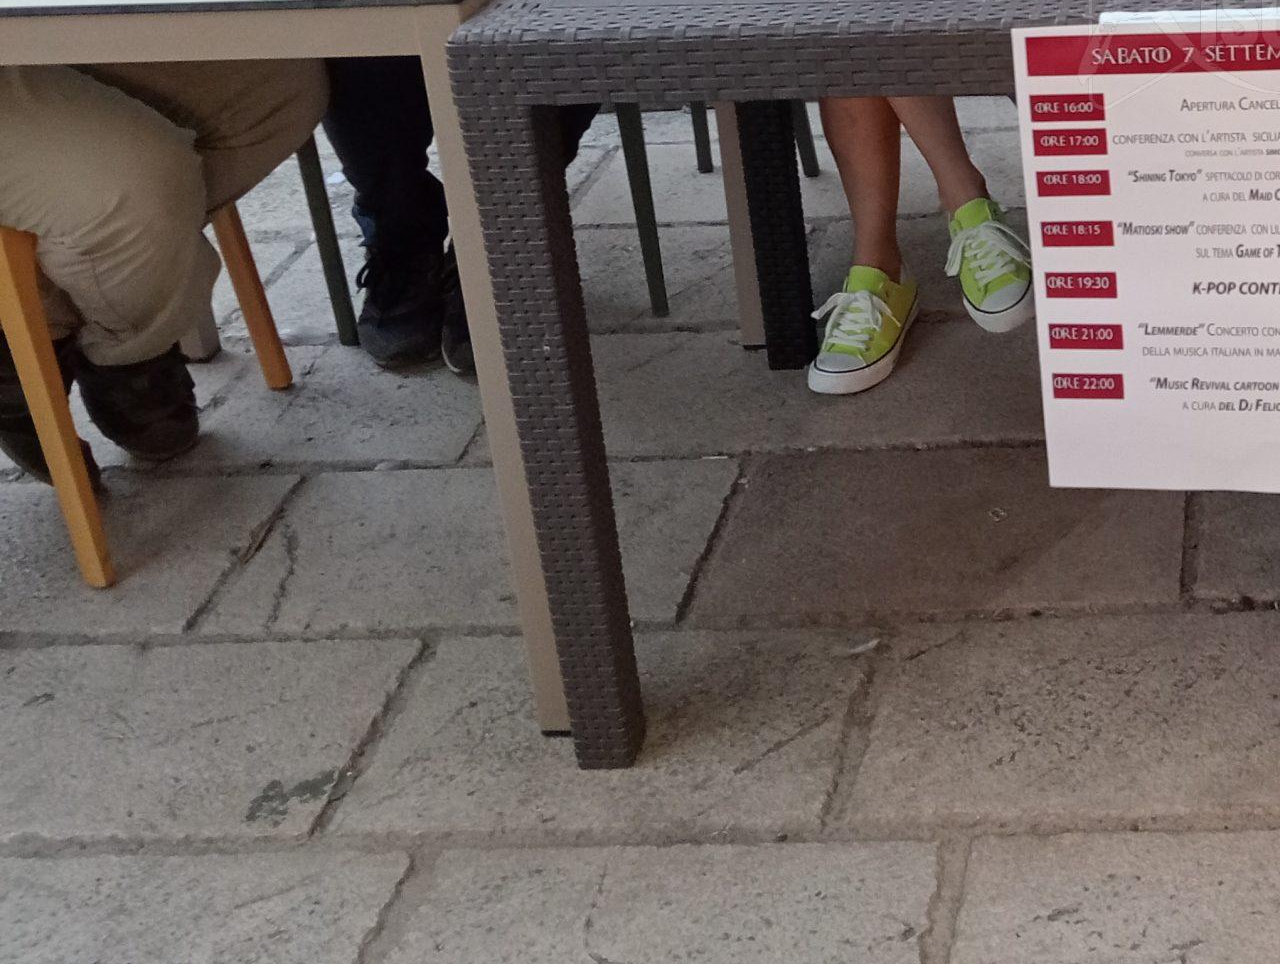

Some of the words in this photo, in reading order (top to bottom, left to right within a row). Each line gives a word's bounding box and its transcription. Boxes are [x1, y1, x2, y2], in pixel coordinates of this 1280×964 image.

[1091, 46, 1172, 65] SABATO
[1182, 47, 1194, 63] 7
[1034, 102, 1060, 113] ORE
[1064, 102, 1093, 113] 16:00
[1040, 135, 1066, 147] ORE
[1069, 135, 1099, 146] 17:00
[1044, 174, 1068, 185] ORE
[1071, 174, 1101, 185] 18:00
[1044, 225, 1068, 235] ORE
[1071, 224, 1101, 235] 18:15
[1047, 277, 1074, 289] ORE
[1077, 277, 1110, 289] 19:30
[1192, 282, 1236, 295] K-POP
[1051, 328, 1078, 340] ORE
[1081, 329, 1114, 341] 21:00
[1054, 377, 1080, 389] ORE
[1083, 377, 1115, 390] 22:00
